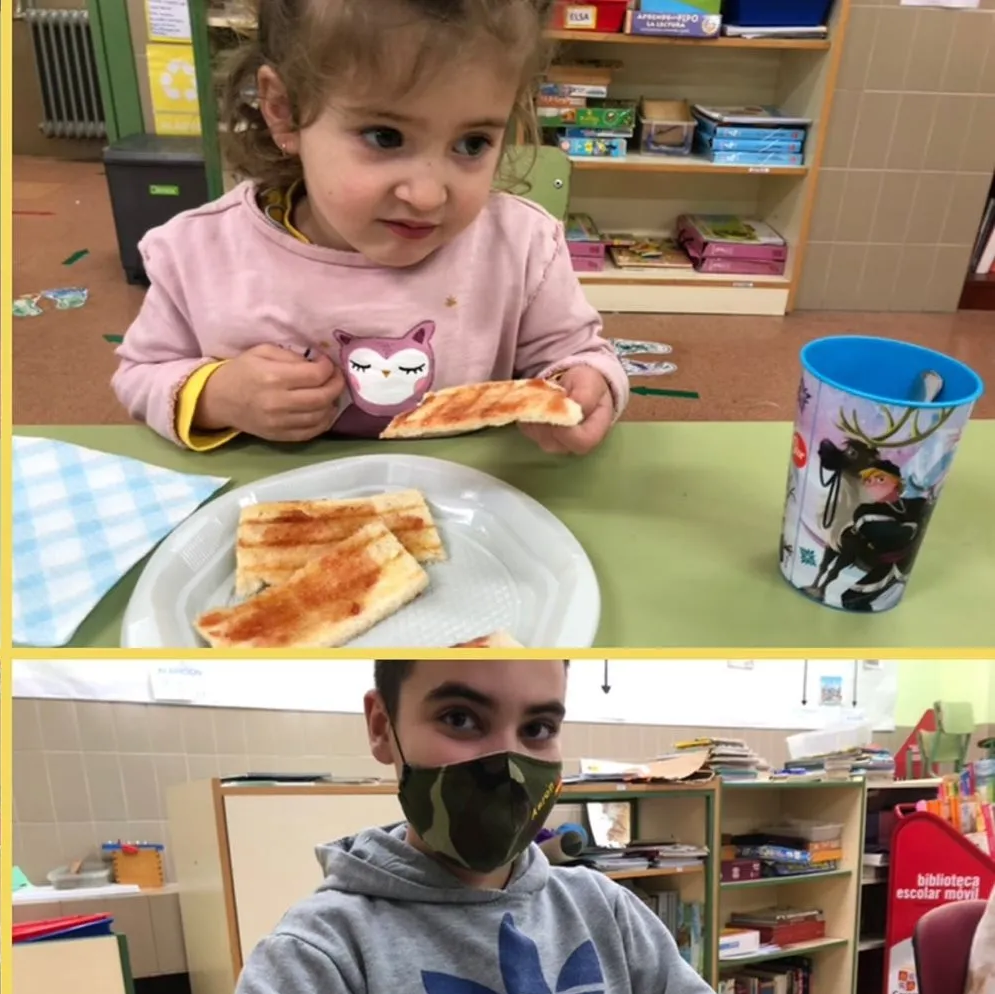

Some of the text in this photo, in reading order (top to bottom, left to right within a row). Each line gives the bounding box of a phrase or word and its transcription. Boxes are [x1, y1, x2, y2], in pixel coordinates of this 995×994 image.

[569, 11, 591, 22] ELSA
[917, 872, 981, 888] biblioteca
[896, 887, 942, 900] escolar
